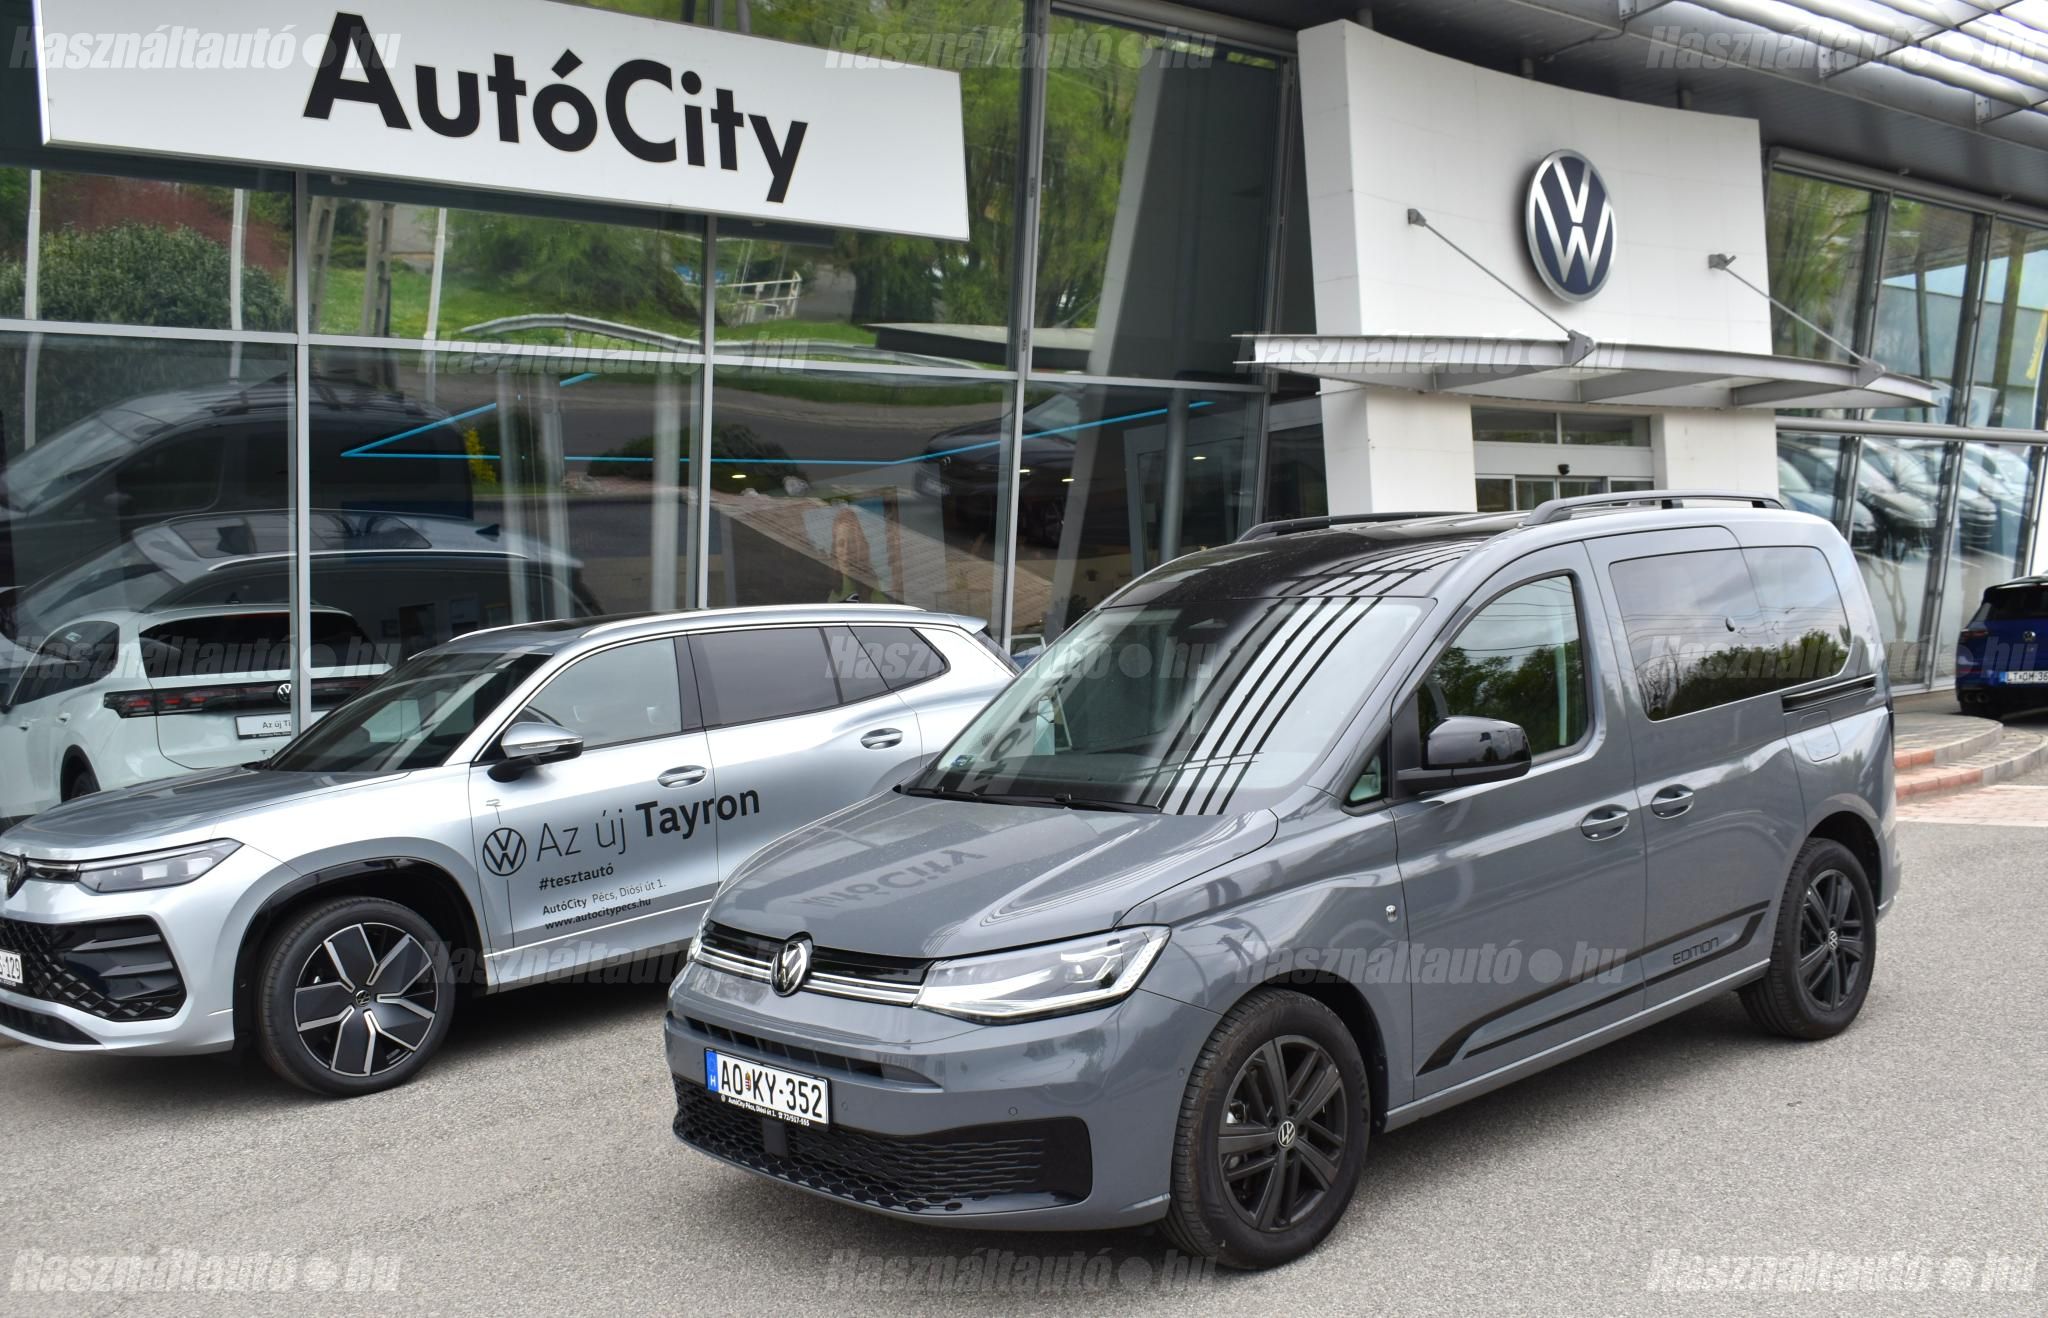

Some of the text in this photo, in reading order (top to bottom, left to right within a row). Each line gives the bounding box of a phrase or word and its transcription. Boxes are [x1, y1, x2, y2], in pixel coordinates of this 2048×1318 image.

[303, 11, 808, 204] AutóCity
[536, 789, 760, 862] Az új Tayron
[538, 862, 614, 891] #tesztautó
[543, 898, 587, 916] AutóCity
[592, 892, 618, 904] Pécs,
[619, 882, 644, 897] Diósi
[645, 880, 656, 892] út
[544, 898, 652, 930] www.autocitypecs.hu
[710, 1076, 717, 1087] H
